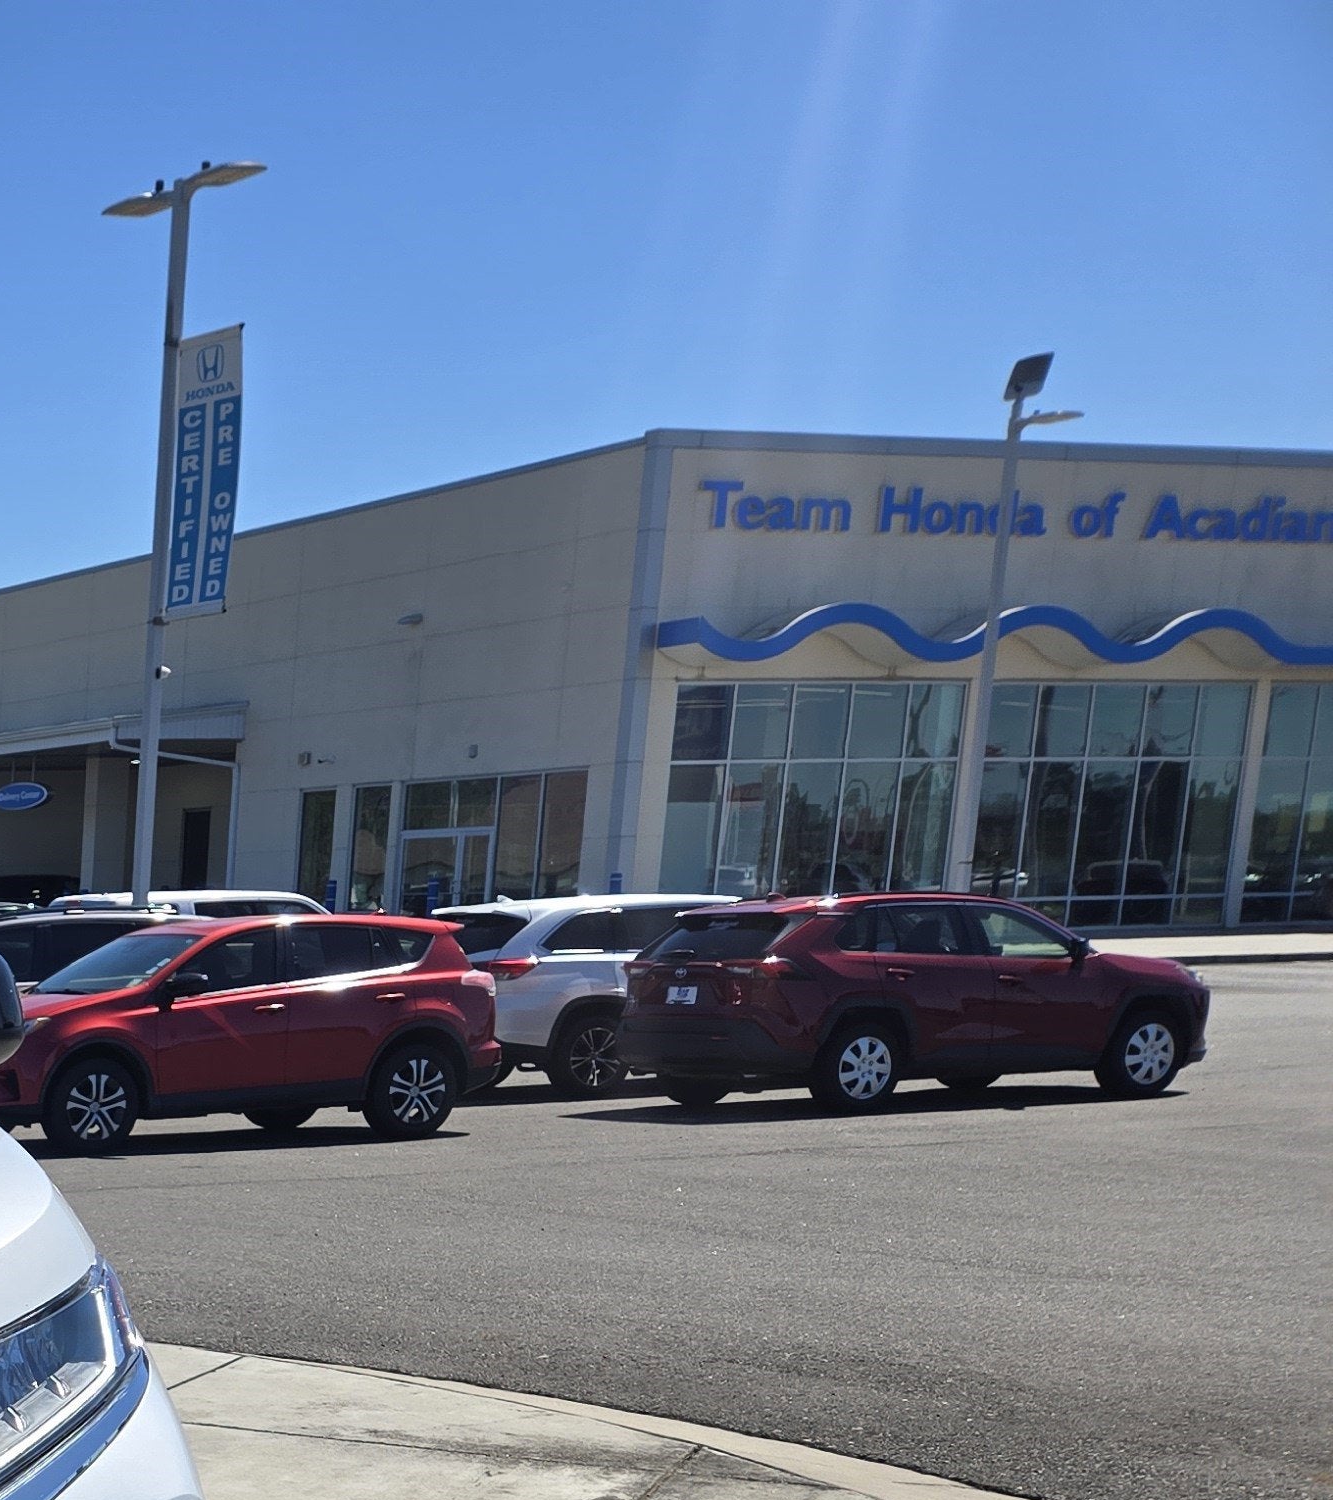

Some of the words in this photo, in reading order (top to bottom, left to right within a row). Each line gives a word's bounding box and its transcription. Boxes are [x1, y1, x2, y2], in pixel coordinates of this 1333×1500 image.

[185, 381, 235, 402] HONDA
[217, 402, 234, 466] PRE
[171, 409, 203, 603] CERTIFIED
[700, 480, 853, 532] Team
[1071, 491, 1127, 539] of
[205, 492, 230, 597] OWNED
